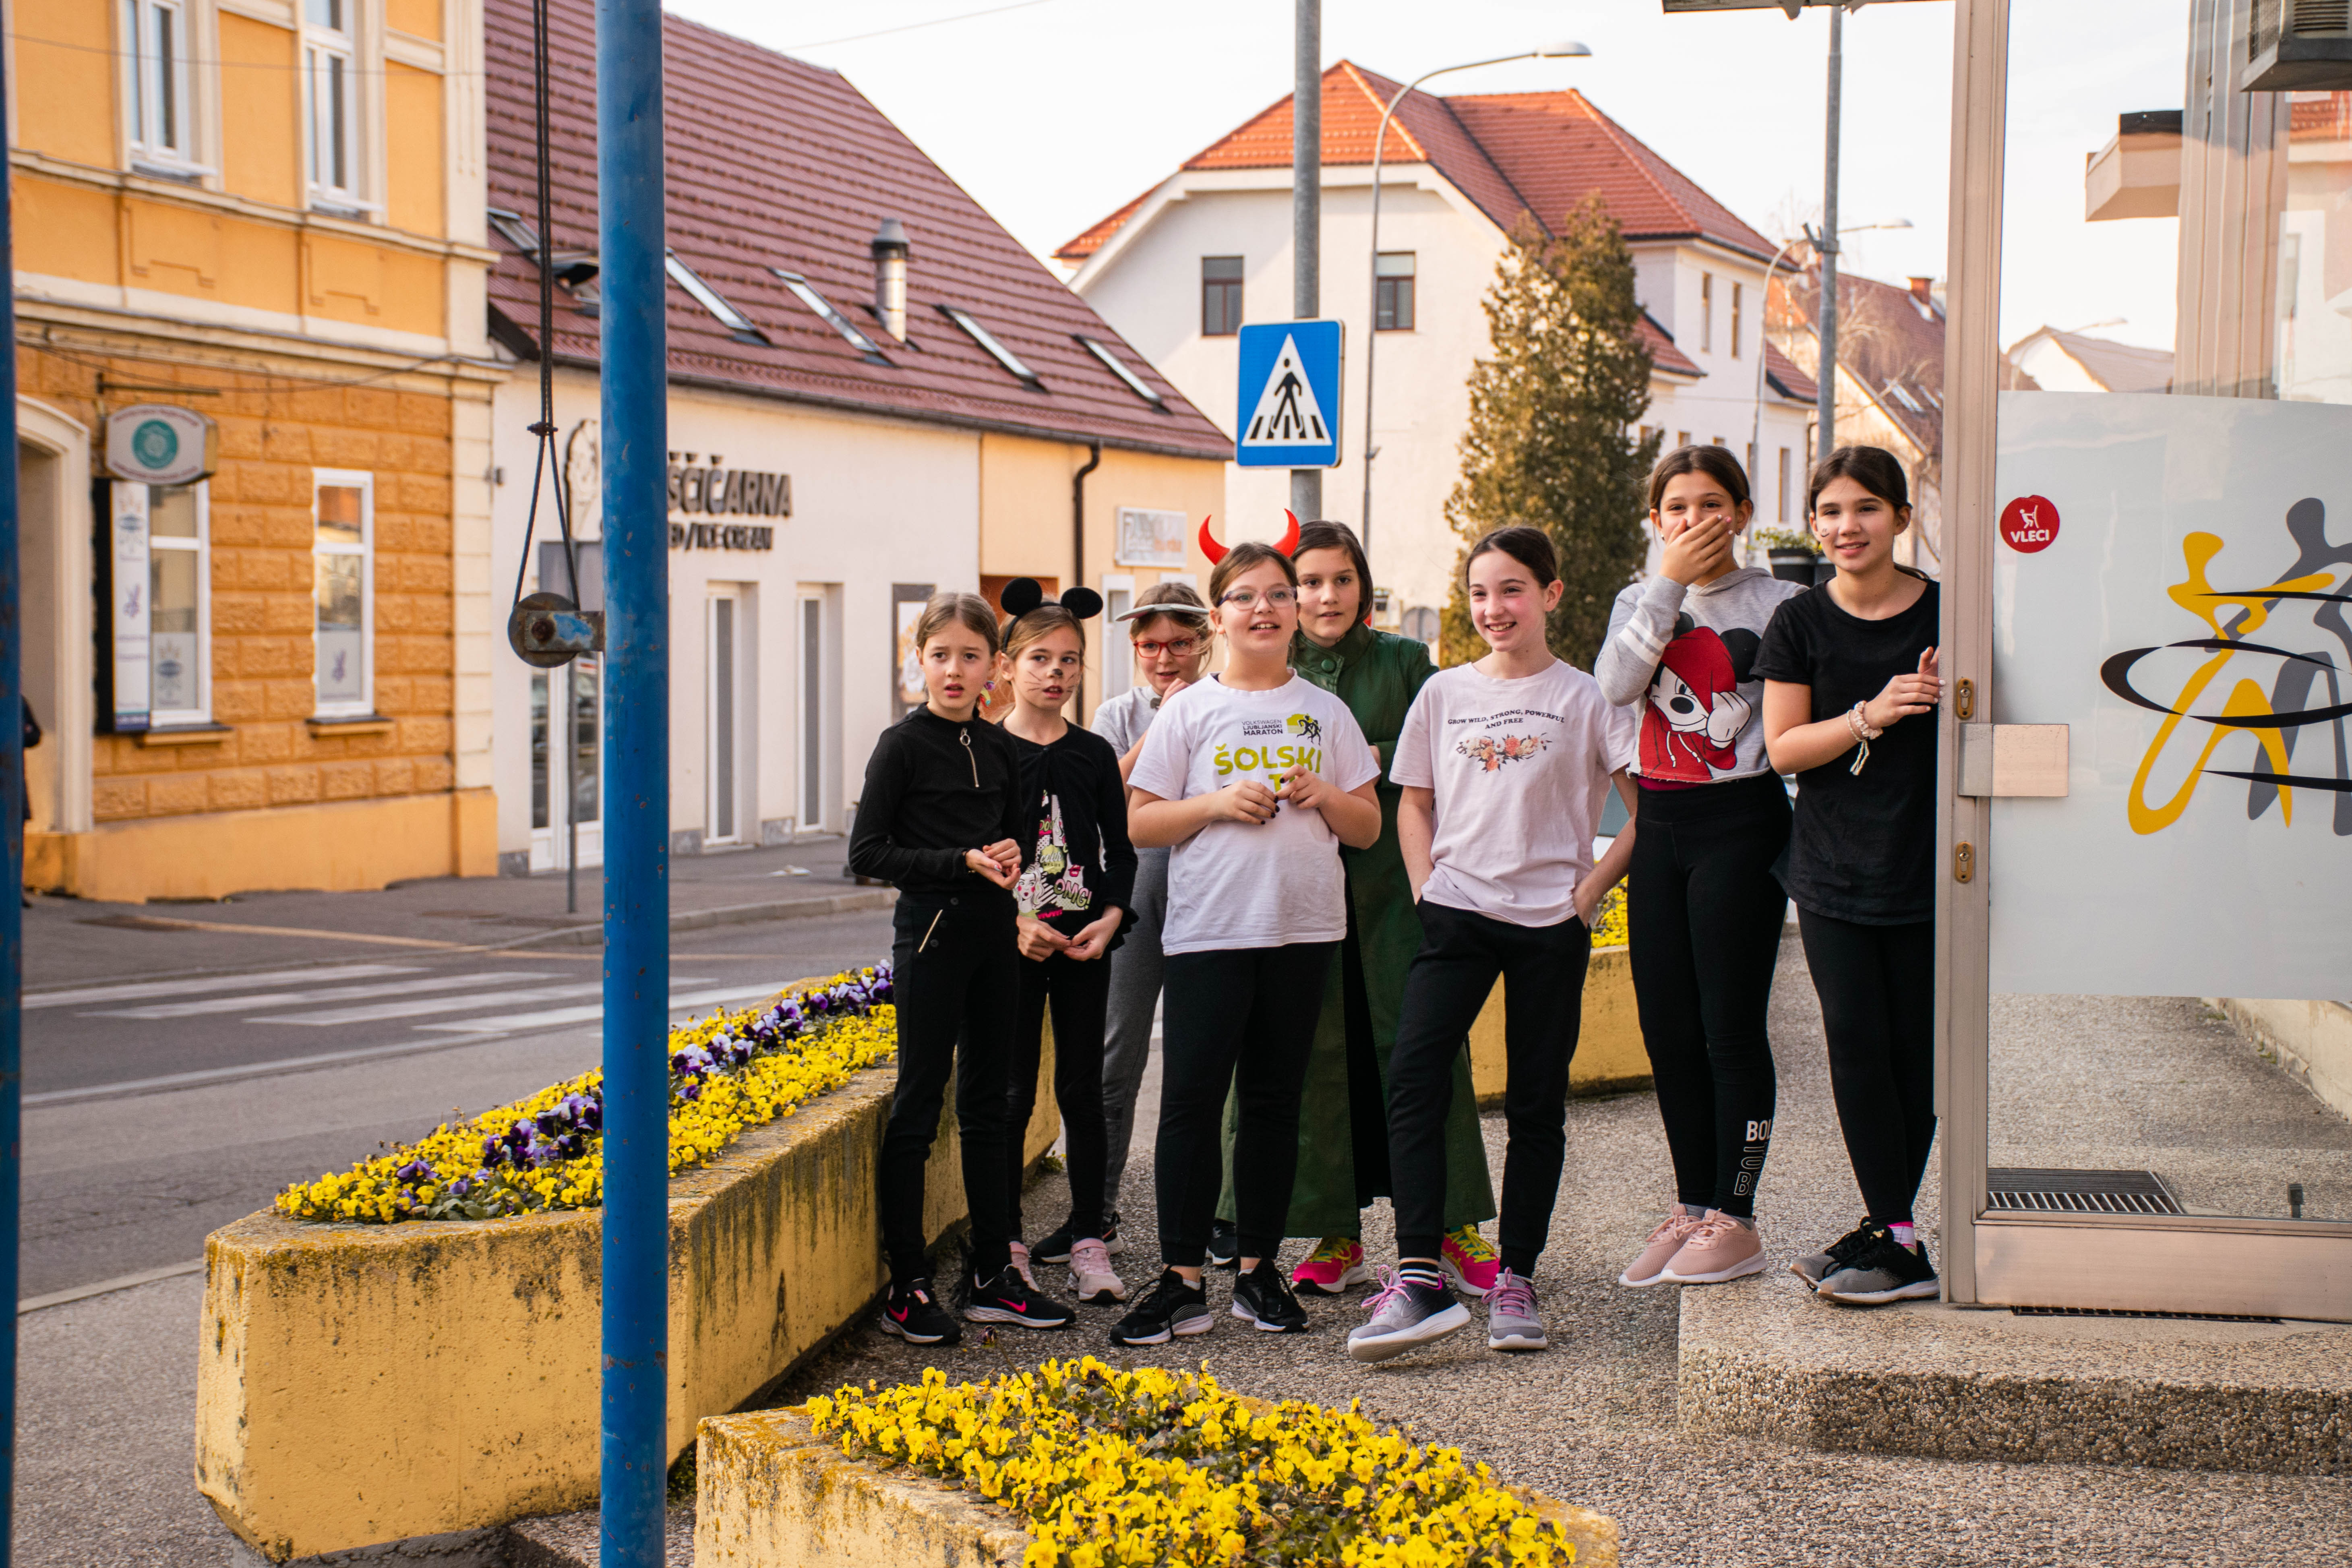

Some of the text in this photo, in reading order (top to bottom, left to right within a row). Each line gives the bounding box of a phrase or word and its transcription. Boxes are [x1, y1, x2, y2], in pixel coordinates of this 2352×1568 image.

[2010, 529, 2050, 543] VLECI
[1490, 709, 1523, 720] STRONG,
[1525, 710, 1565, 723] POWERFUL
[1485, 721, 1502, 729] AND
[1214, 743, 1322, 775] ŠOLSKI
[1053, 878, 1092, 910] OMG!
